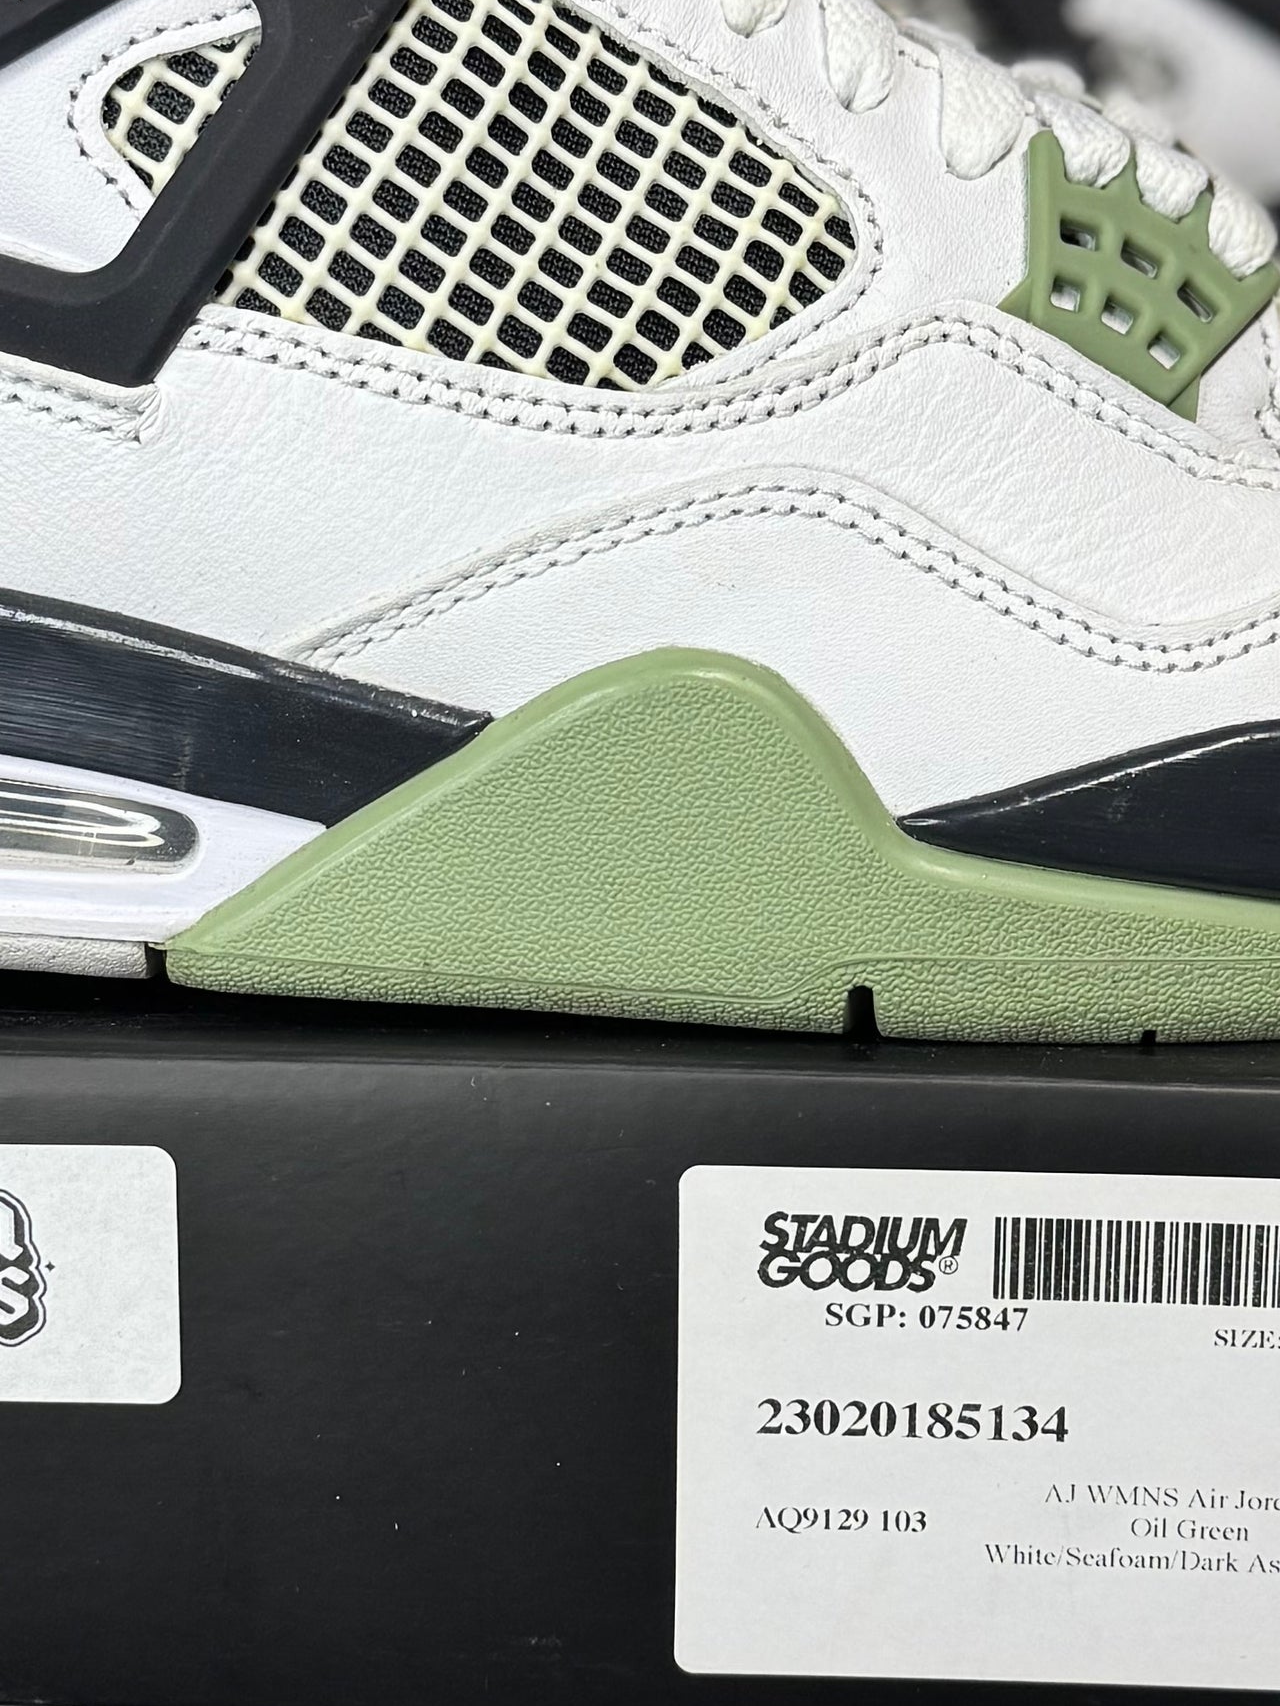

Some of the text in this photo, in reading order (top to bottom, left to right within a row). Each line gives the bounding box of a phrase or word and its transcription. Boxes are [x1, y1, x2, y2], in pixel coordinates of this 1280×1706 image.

[759, 1211, 968, 1256] STADIUM
[824, 1302, 1030, 1332] SGP: 075847
[755, 1397, 1070, 1443] 23020185134
[1044, 1483, 1077, 1505] AJ
[1086, 1484, 1180, 1509] WMNS
[1187, 1487, 1229, 1511] Air
[754, 1506, 929, 1534] AQ9129 103
[1130, 1516, 1250, 1542] Oil Green
[984, 1543, 1240, 1574] White/Seafoam/Dark
